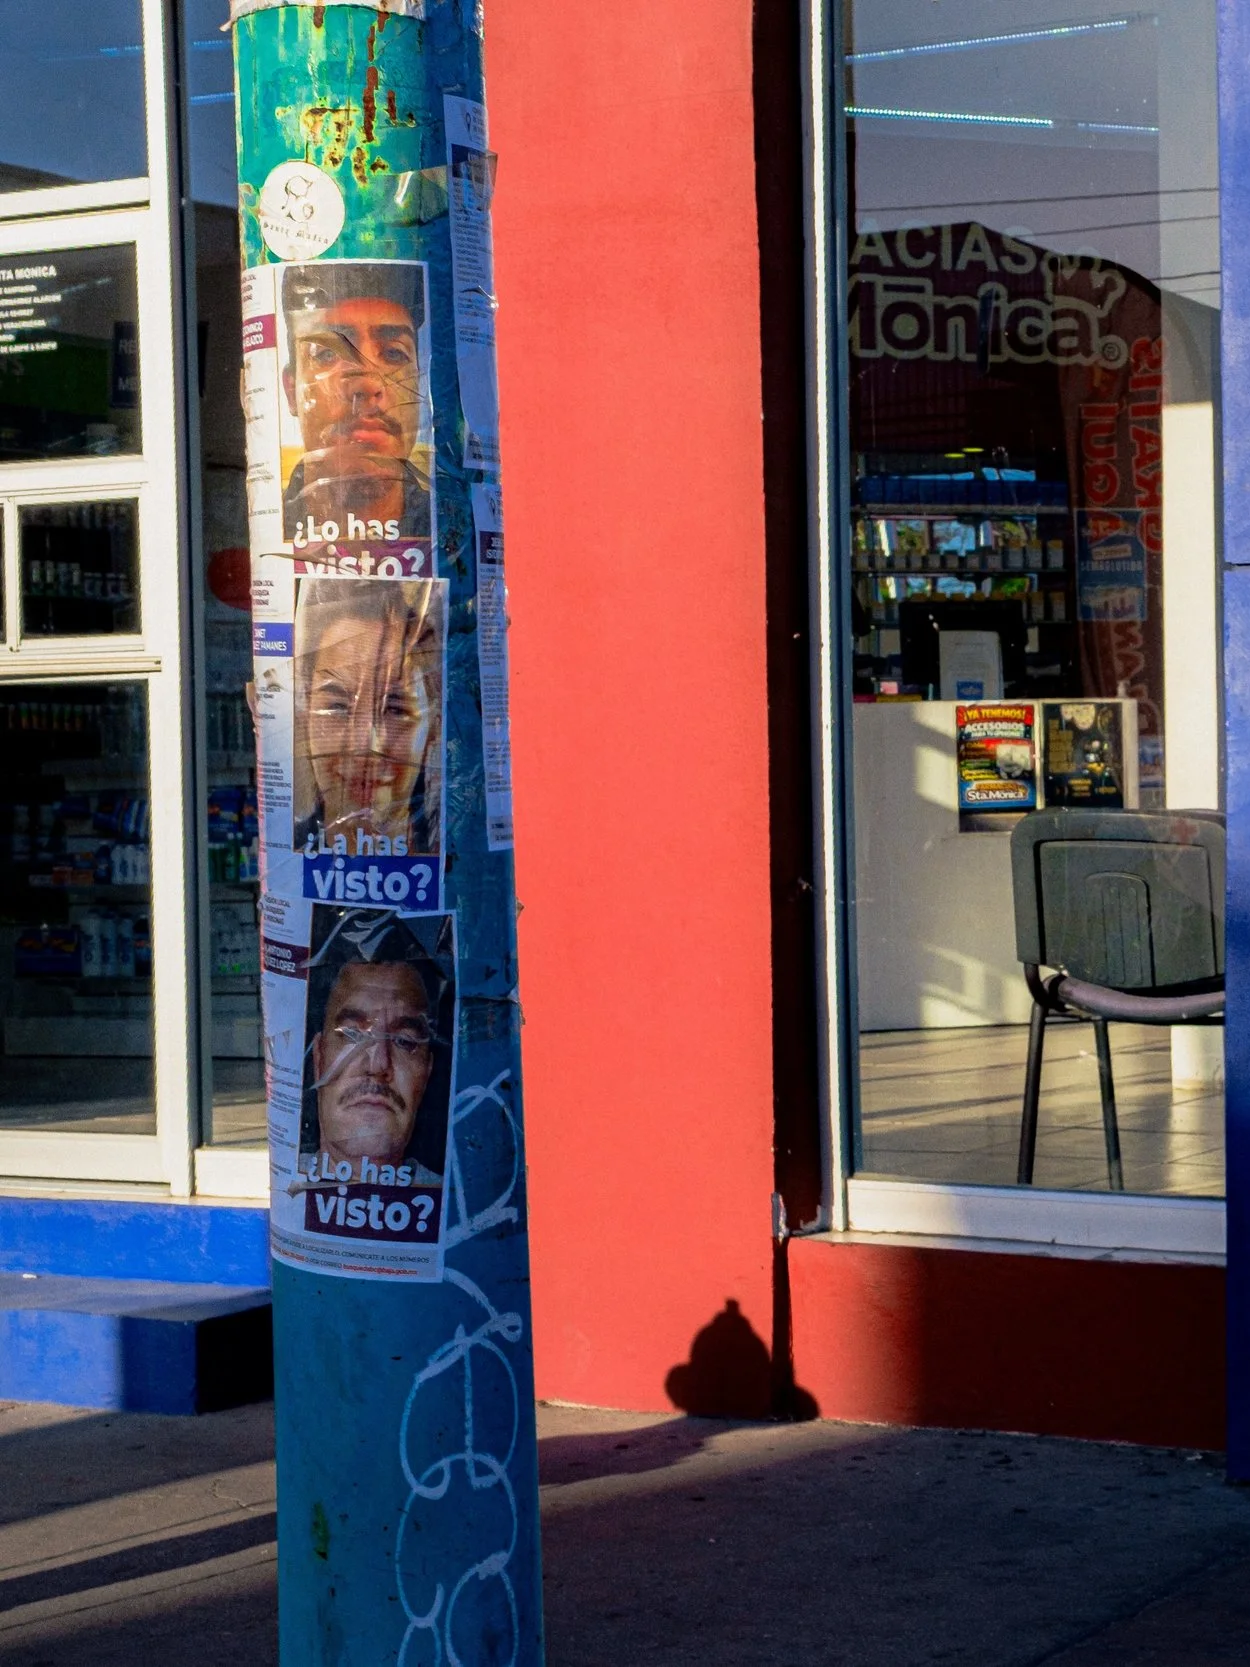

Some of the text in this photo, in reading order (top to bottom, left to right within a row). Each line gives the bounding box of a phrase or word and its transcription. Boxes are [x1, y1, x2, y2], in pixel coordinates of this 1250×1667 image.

[293, 513, 400, 548] ¿Lo has
[303, 544, 425, 578] visto?
[964, 722, 1025, 732] ACCESORIOS
[981, 707, 1027, 720] TENEMOS!
[304, 827, 409, 860] ¿La has
[312, 857, 433, 902] visto?
[306, 1152, 353, 1183] ¿Lo
[361, 1156, 413, 1187] has
[315, 1185, 435, 1233] visto?
